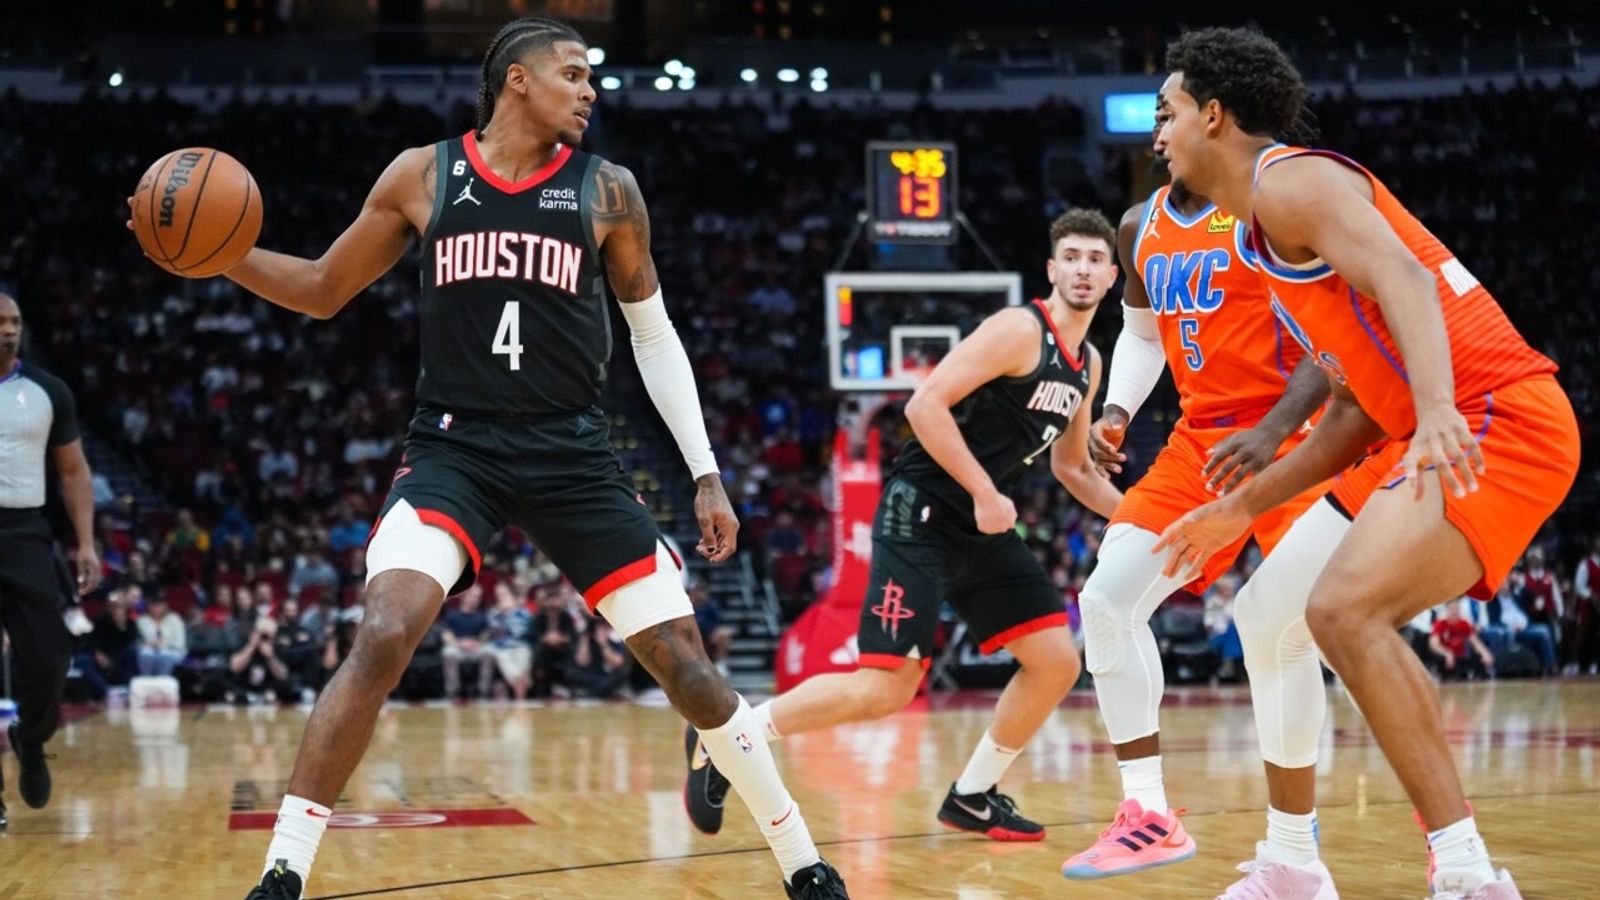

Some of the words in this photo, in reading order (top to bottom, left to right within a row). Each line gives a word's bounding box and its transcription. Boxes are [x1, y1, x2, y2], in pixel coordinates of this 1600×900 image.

[159, 152, 204, 228] Wilson
[452, 160, 467, 176] 6
[541, 187, 577, 199] credit
[539, 199, 578, 211] karma
[899, 175, 941, 218] 13
[434, 230, 583, 295] HOUSTON
[1144, 248, 1231, 316] OKC
[491, 300, 524, 371] 4
[1179, 318, 1204, 372] 5
